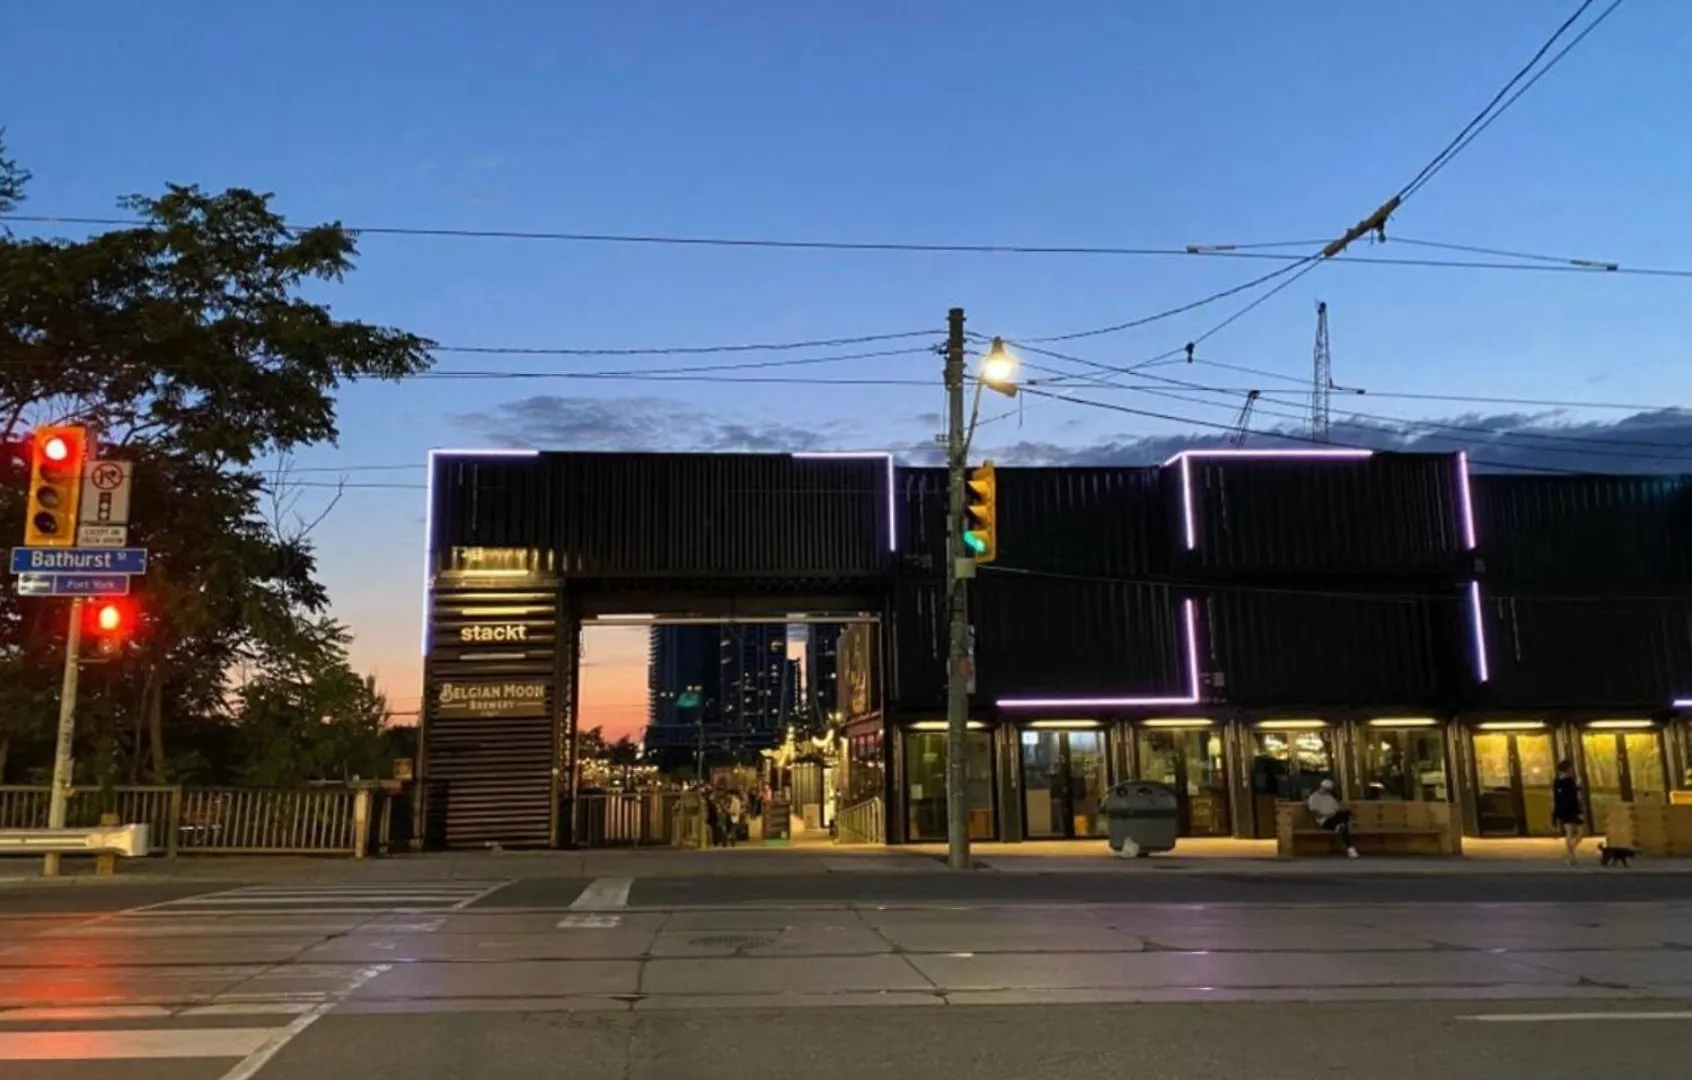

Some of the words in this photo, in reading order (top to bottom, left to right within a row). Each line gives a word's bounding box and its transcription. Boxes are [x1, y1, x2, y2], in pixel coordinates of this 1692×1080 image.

[31, 550, 111, 568] Bathurst
[93, 580, 115, 589] York
[461, 625, 527, 641] stackt
[439, 682, 501, 703] BELGIAN
[503, 683, 545, 698] MOON
[469, 700, 515, 710] BREWERY
